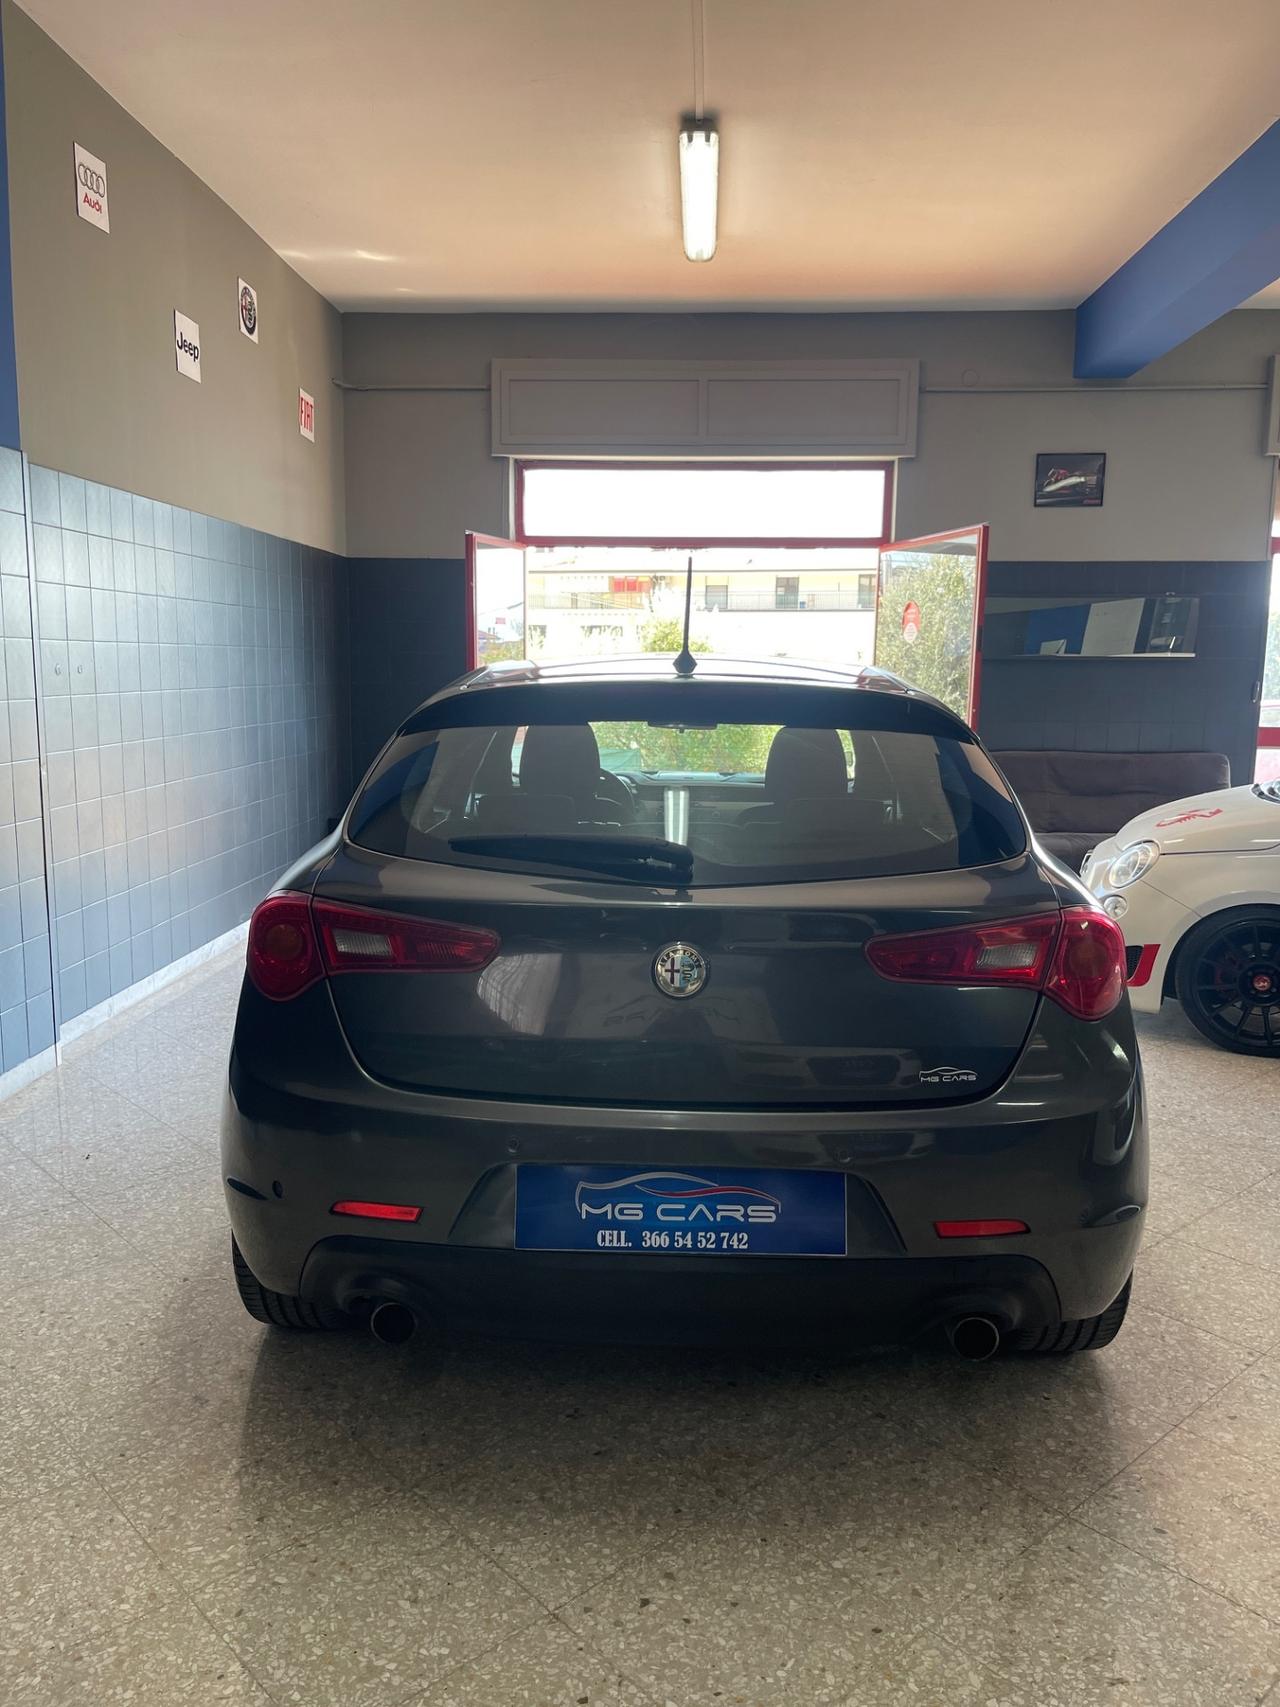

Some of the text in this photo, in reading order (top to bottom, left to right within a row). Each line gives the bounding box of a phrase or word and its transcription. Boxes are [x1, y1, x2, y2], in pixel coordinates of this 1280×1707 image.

[83, 192, 103, 214] Audi
[176, 331, 200, 362] Jeep
[300, 396, 314, 433] FIAT
[920, 1074, 977, 1083] MG CARS
[581, 1202, 777, 1223] MG CARS
[596, 1229, 749, 1249] CELL. 366 54 52 742
